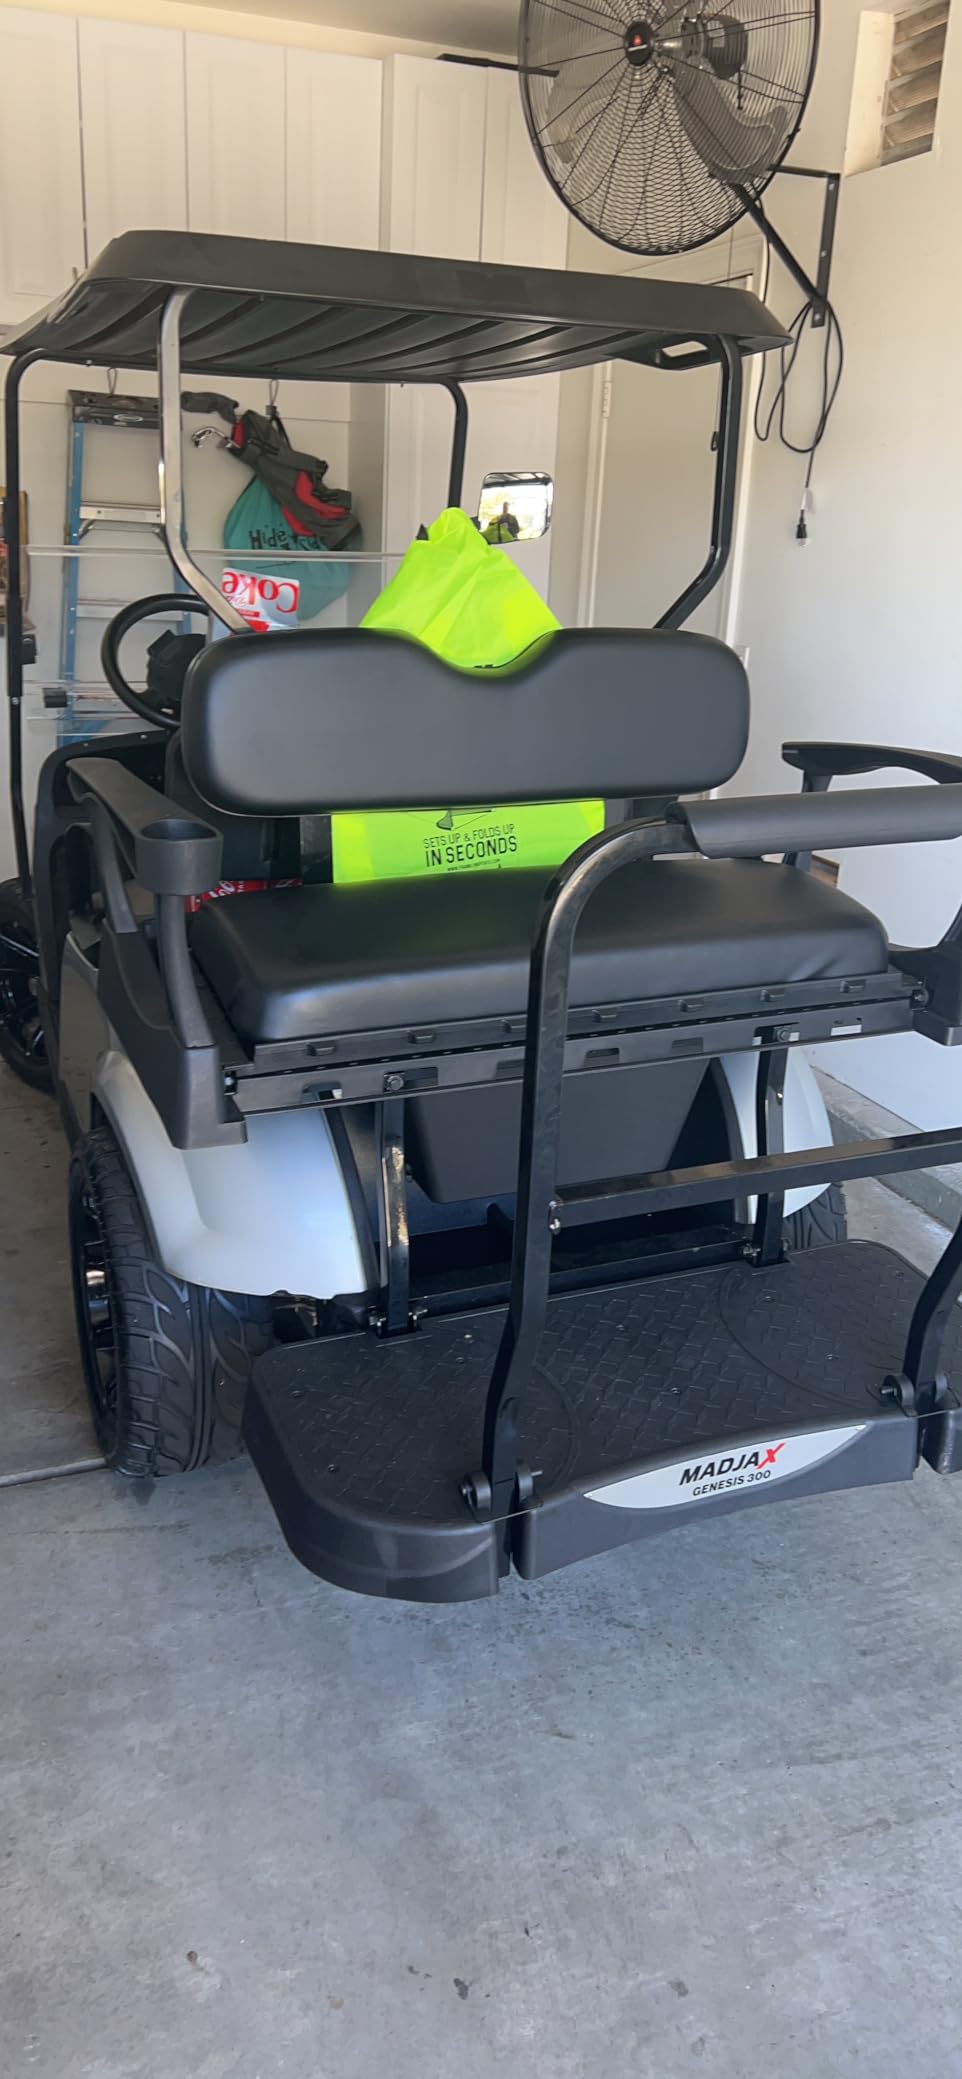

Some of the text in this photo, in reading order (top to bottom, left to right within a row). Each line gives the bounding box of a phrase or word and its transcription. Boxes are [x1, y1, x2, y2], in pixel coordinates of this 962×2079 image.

[221, 572, 299, 613] Coke
[423, 824, 515, 849] SETS UP & FOLDS UP
[425, 848, 442, 868] IN
[445, 835, 517, 863] SECONDS
[679, 1442, 785, 1486] MADJAX
[692, 1469, 771, 1496] GENESIS 300
